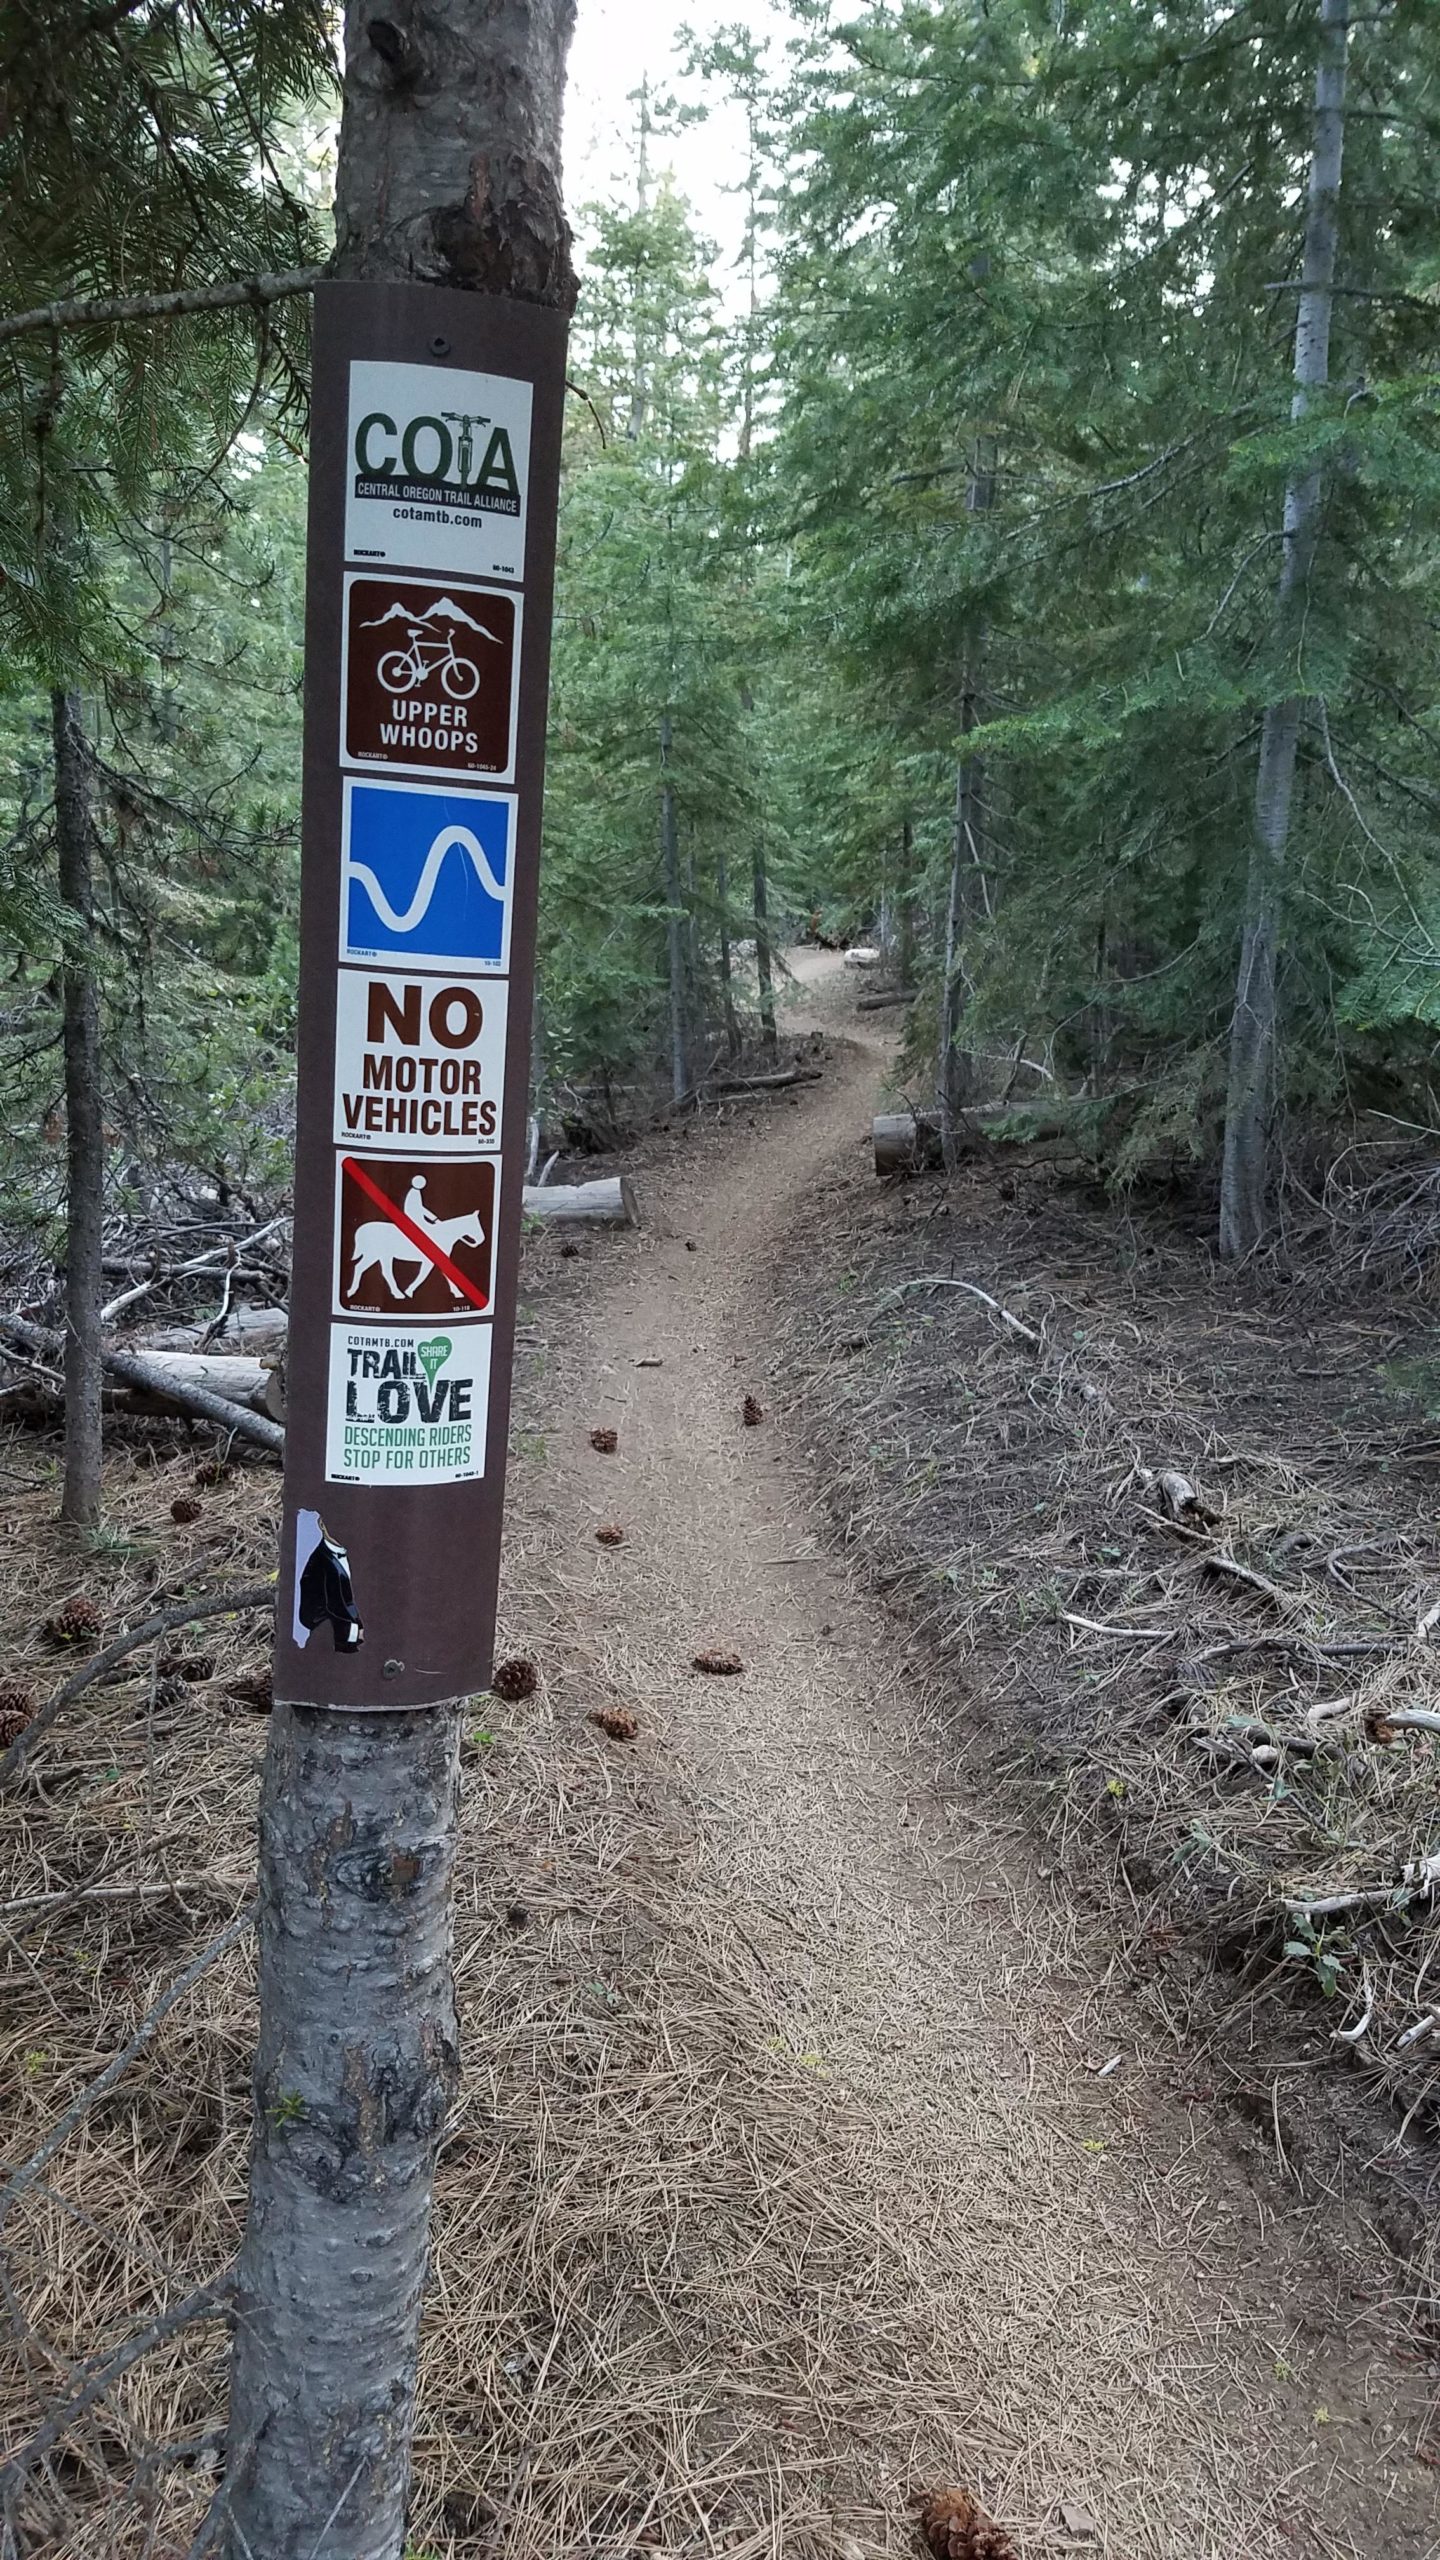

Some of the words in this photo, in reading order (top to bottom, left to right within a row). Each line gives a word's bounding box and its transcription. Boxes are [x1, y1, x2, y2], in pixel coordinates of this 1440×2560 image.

[355, 412, 520, 496] COTA
[358, 482, 400, 497] CENTRAL
[403, 485, 442, 501] OREGON
[444, 490, 472, 506] TRAIL
[474, 496, 517, 513] ALLIANCE
[393, 507, 482, 528] cotamtb.com
[392, 699, 468, 728] UPPER
[380, 723, 478, 753] WHOOPS
[367, 981, 483, 1049] NO
[363, 1053, 481, 1095] MOTOR
[342, 1093, 497, 1136] VEHICLES
[348, 1336, 414, 1348] COTAMTB.COM
[420, 1345, 449, 1358] SHARE
[347, 1348, 426, 1380] TRAIL
[429, 1358, 438, 1370] IT
[345, 1378, 473, 1423] LOVE
[344, 1426, 425, 1447] DESCENDING
[429, 1424, 472, 1446] RIDERS
[344, 1448, 380, 1469] STOP
[386, 1450, 413, 1469] FOR
[419, 1446, 471, 1468] OTHERS
